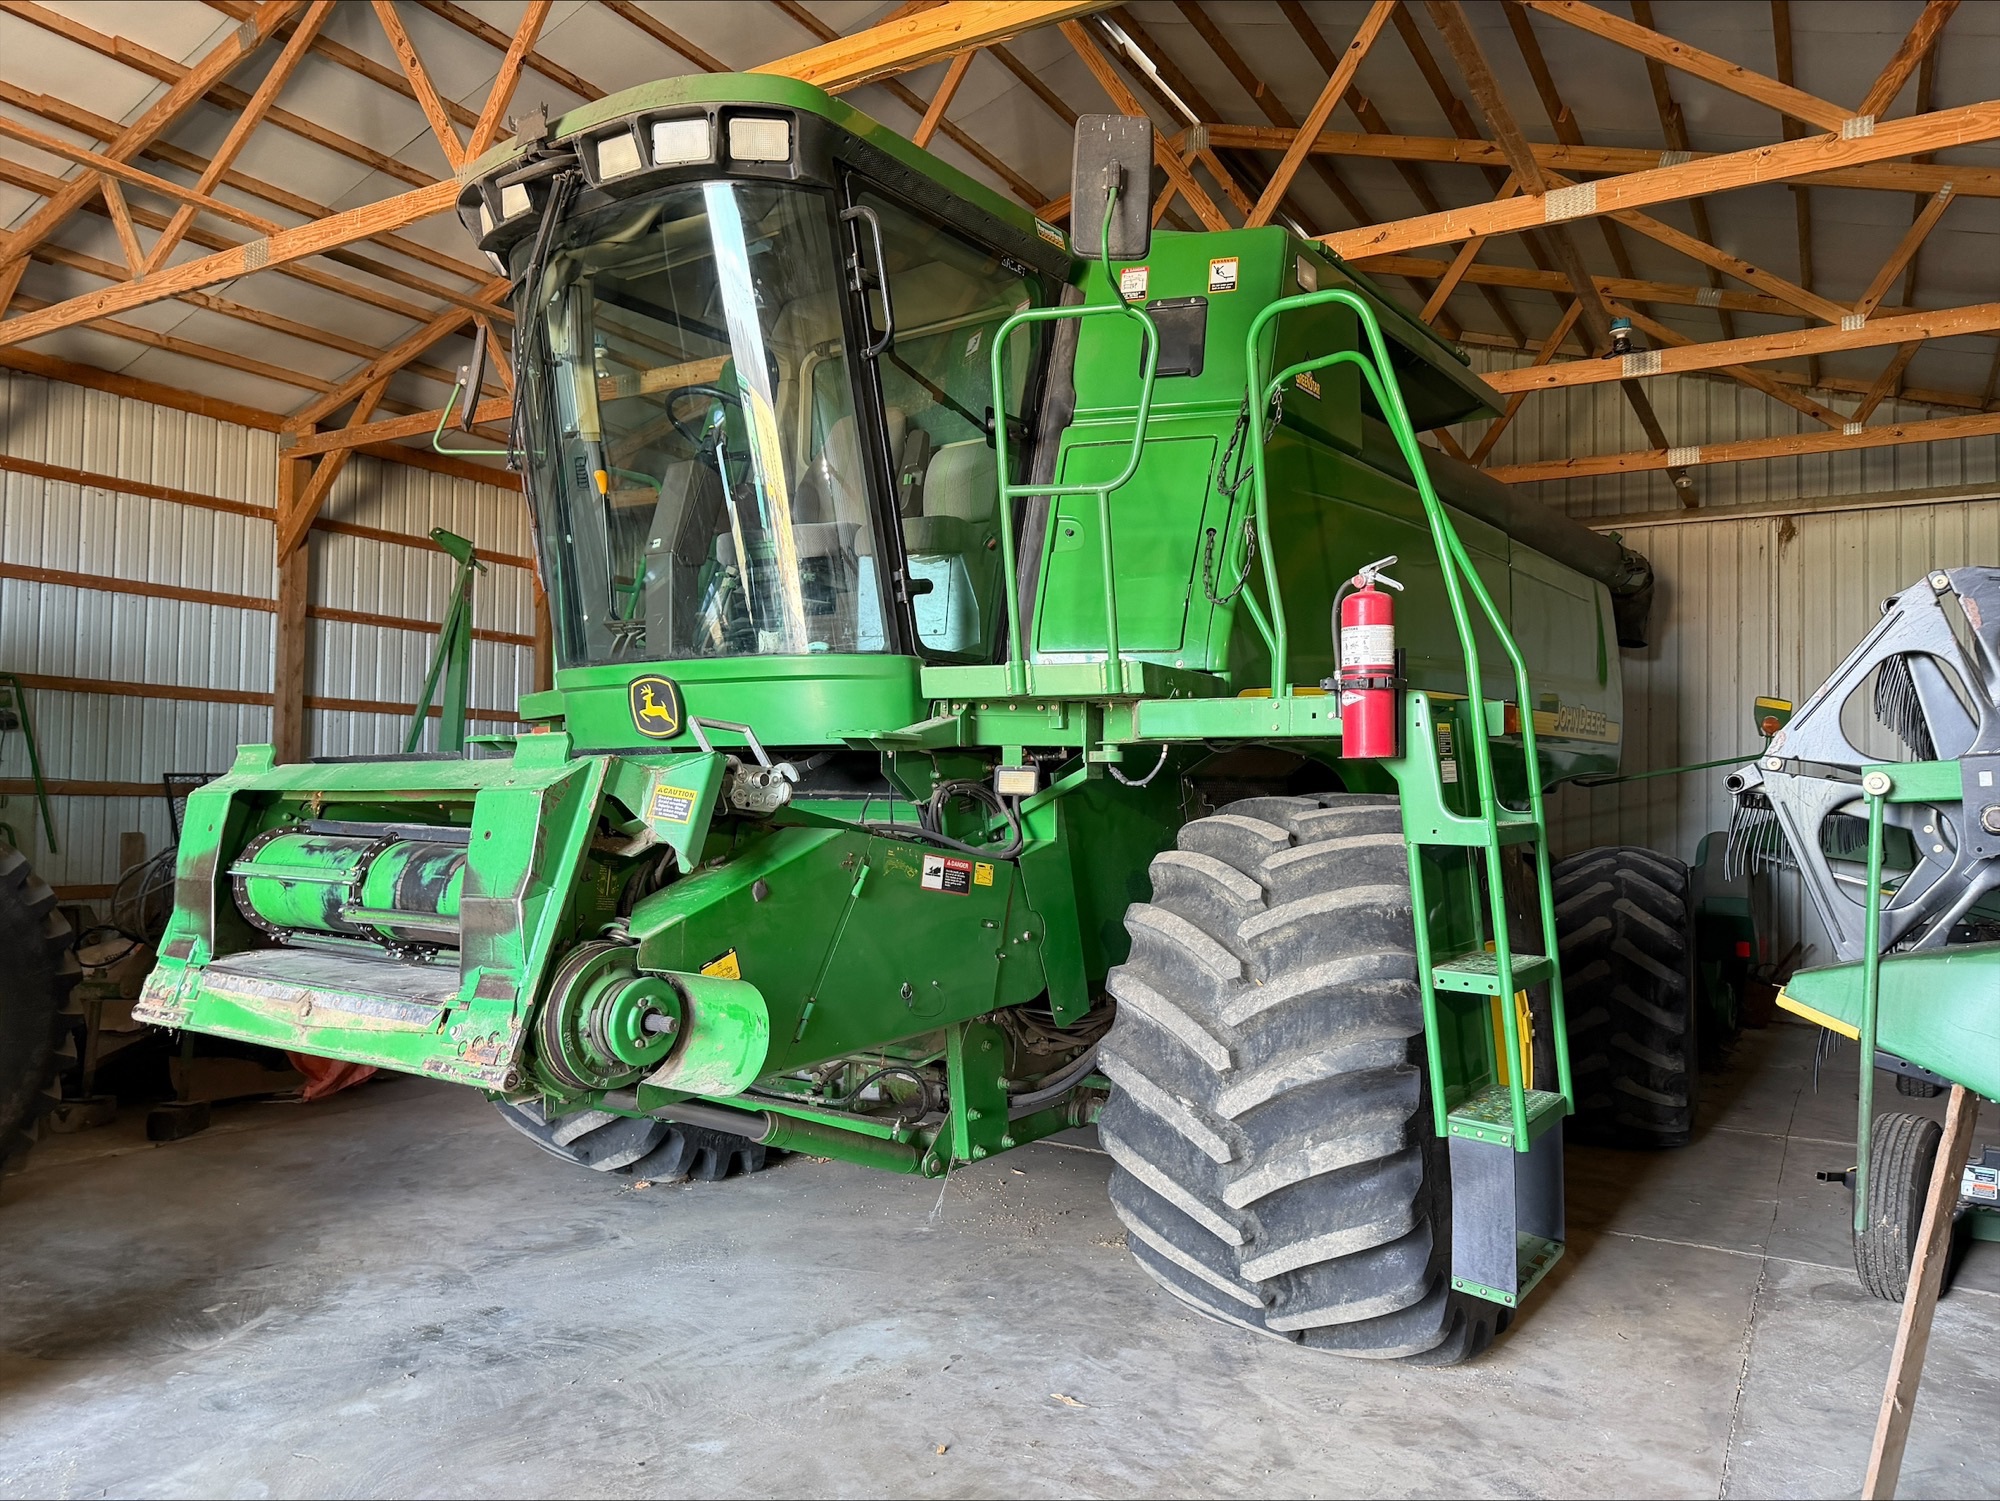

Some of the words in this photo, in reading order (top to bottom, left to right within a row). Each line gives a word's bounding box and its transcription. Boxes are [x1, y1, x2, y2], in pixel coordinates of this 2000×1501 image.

[1579, 703, 1607, 736] DEERE
[663, 787, 695, 799] CAUTION
[950, 860, 970, 869] DANGER
